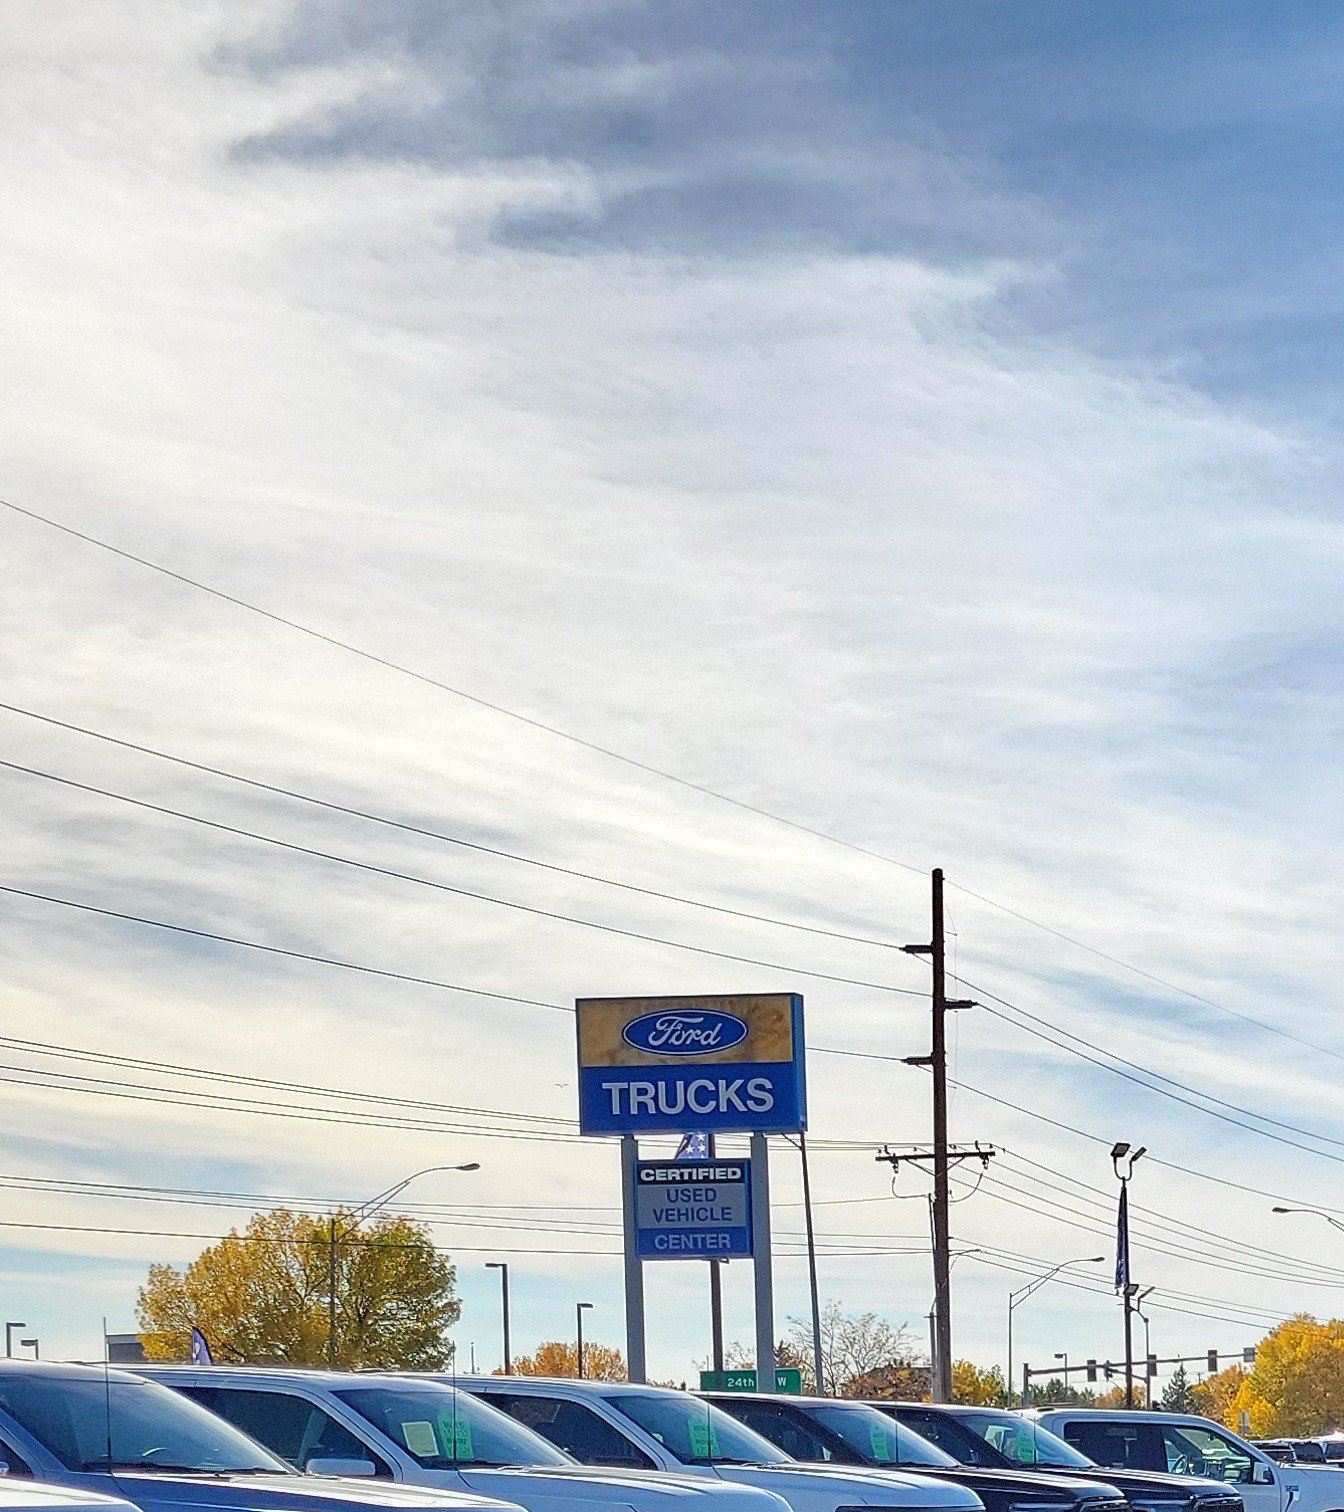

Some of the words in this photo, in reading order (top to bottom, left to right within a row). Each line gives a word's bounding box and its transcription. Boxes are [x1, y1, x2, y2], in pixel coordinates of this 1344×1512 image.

[648, 1016, 722, 1046] Ford
[602, 1078, 775, 1115] TRUCKS
[640, 1167, 742, 1182] CERTIFIED
[667, 1188, 717, 1203] USED
[653, 1206, 733, 1223] VEHICLE
[654, 1233, 731, 1250] CENTER
[727, 1377, 755, 1387] 24th
[777, 1376, 787, 1387] W
